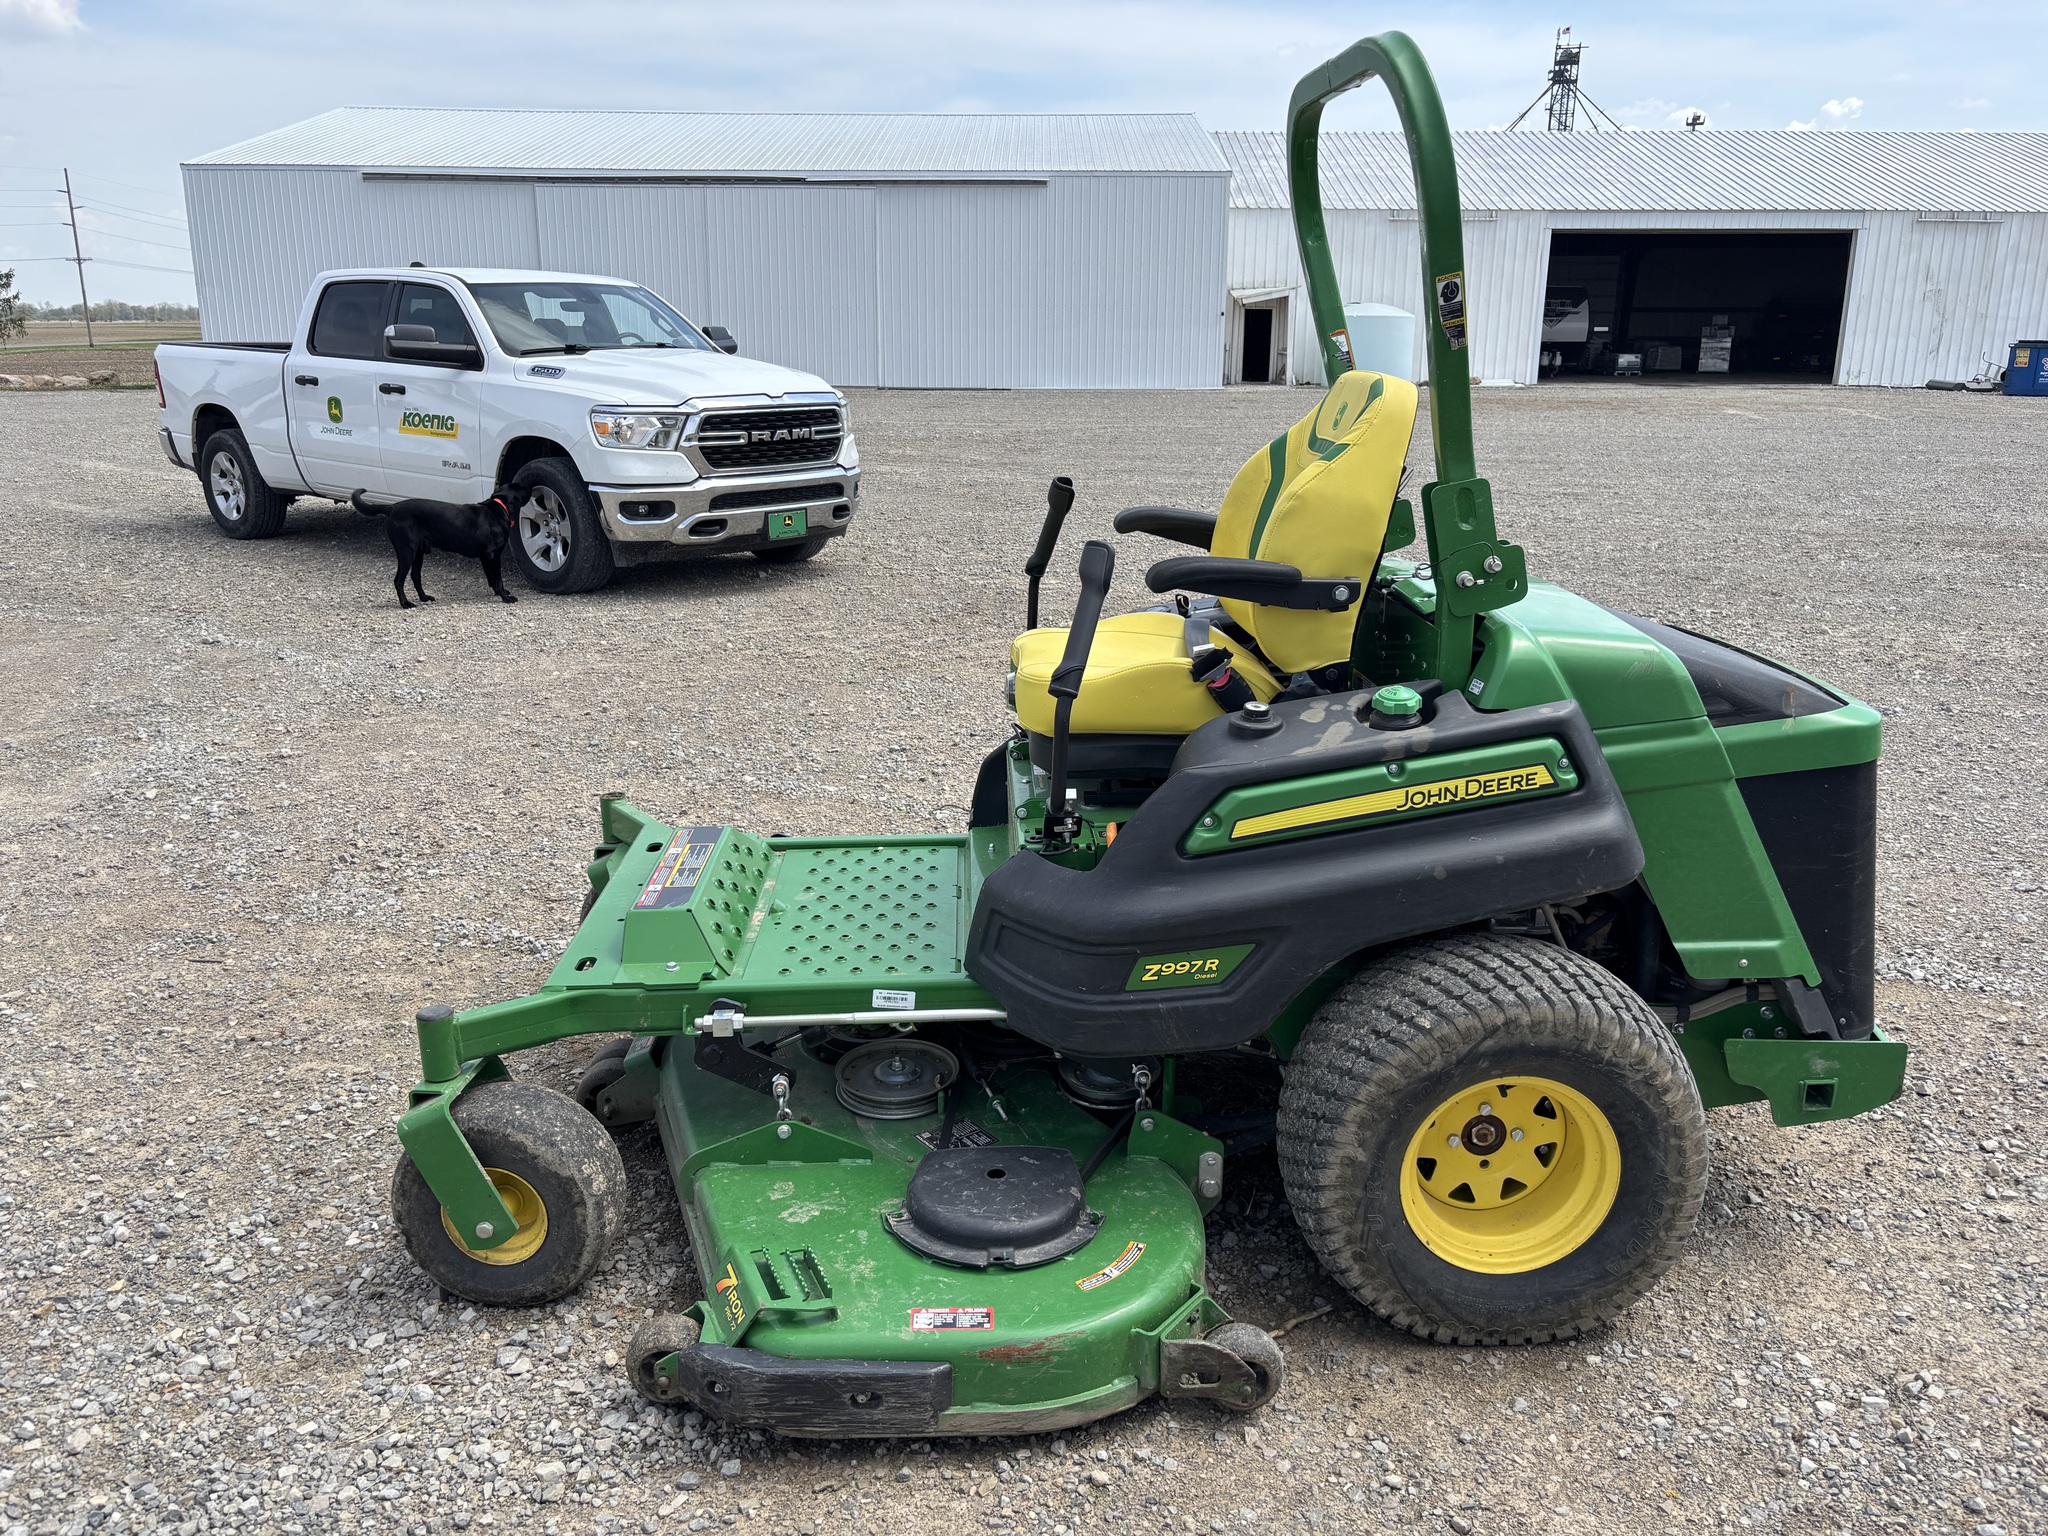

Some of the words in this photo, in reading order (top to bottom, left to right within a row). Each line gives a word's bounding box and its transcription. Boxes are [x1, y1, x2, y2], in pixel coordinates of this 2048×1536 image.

[320, 425, 335, 434] JOHN
[335, 426, 353, 437] DEERE
[751, 428, 810, 442] RAM
[442, 459, 471, 470] RAM
[1396, 784, 1459, 809] JOHN
[1465, 771, 1538, 797] DEERE
[1194, 972, 1218, 980] Diesel
[1602, 1172, 1670, 1277] KENDA
[724, 1305, 733, 1321] PRO
[730, 1320, 737, 1332] 72
